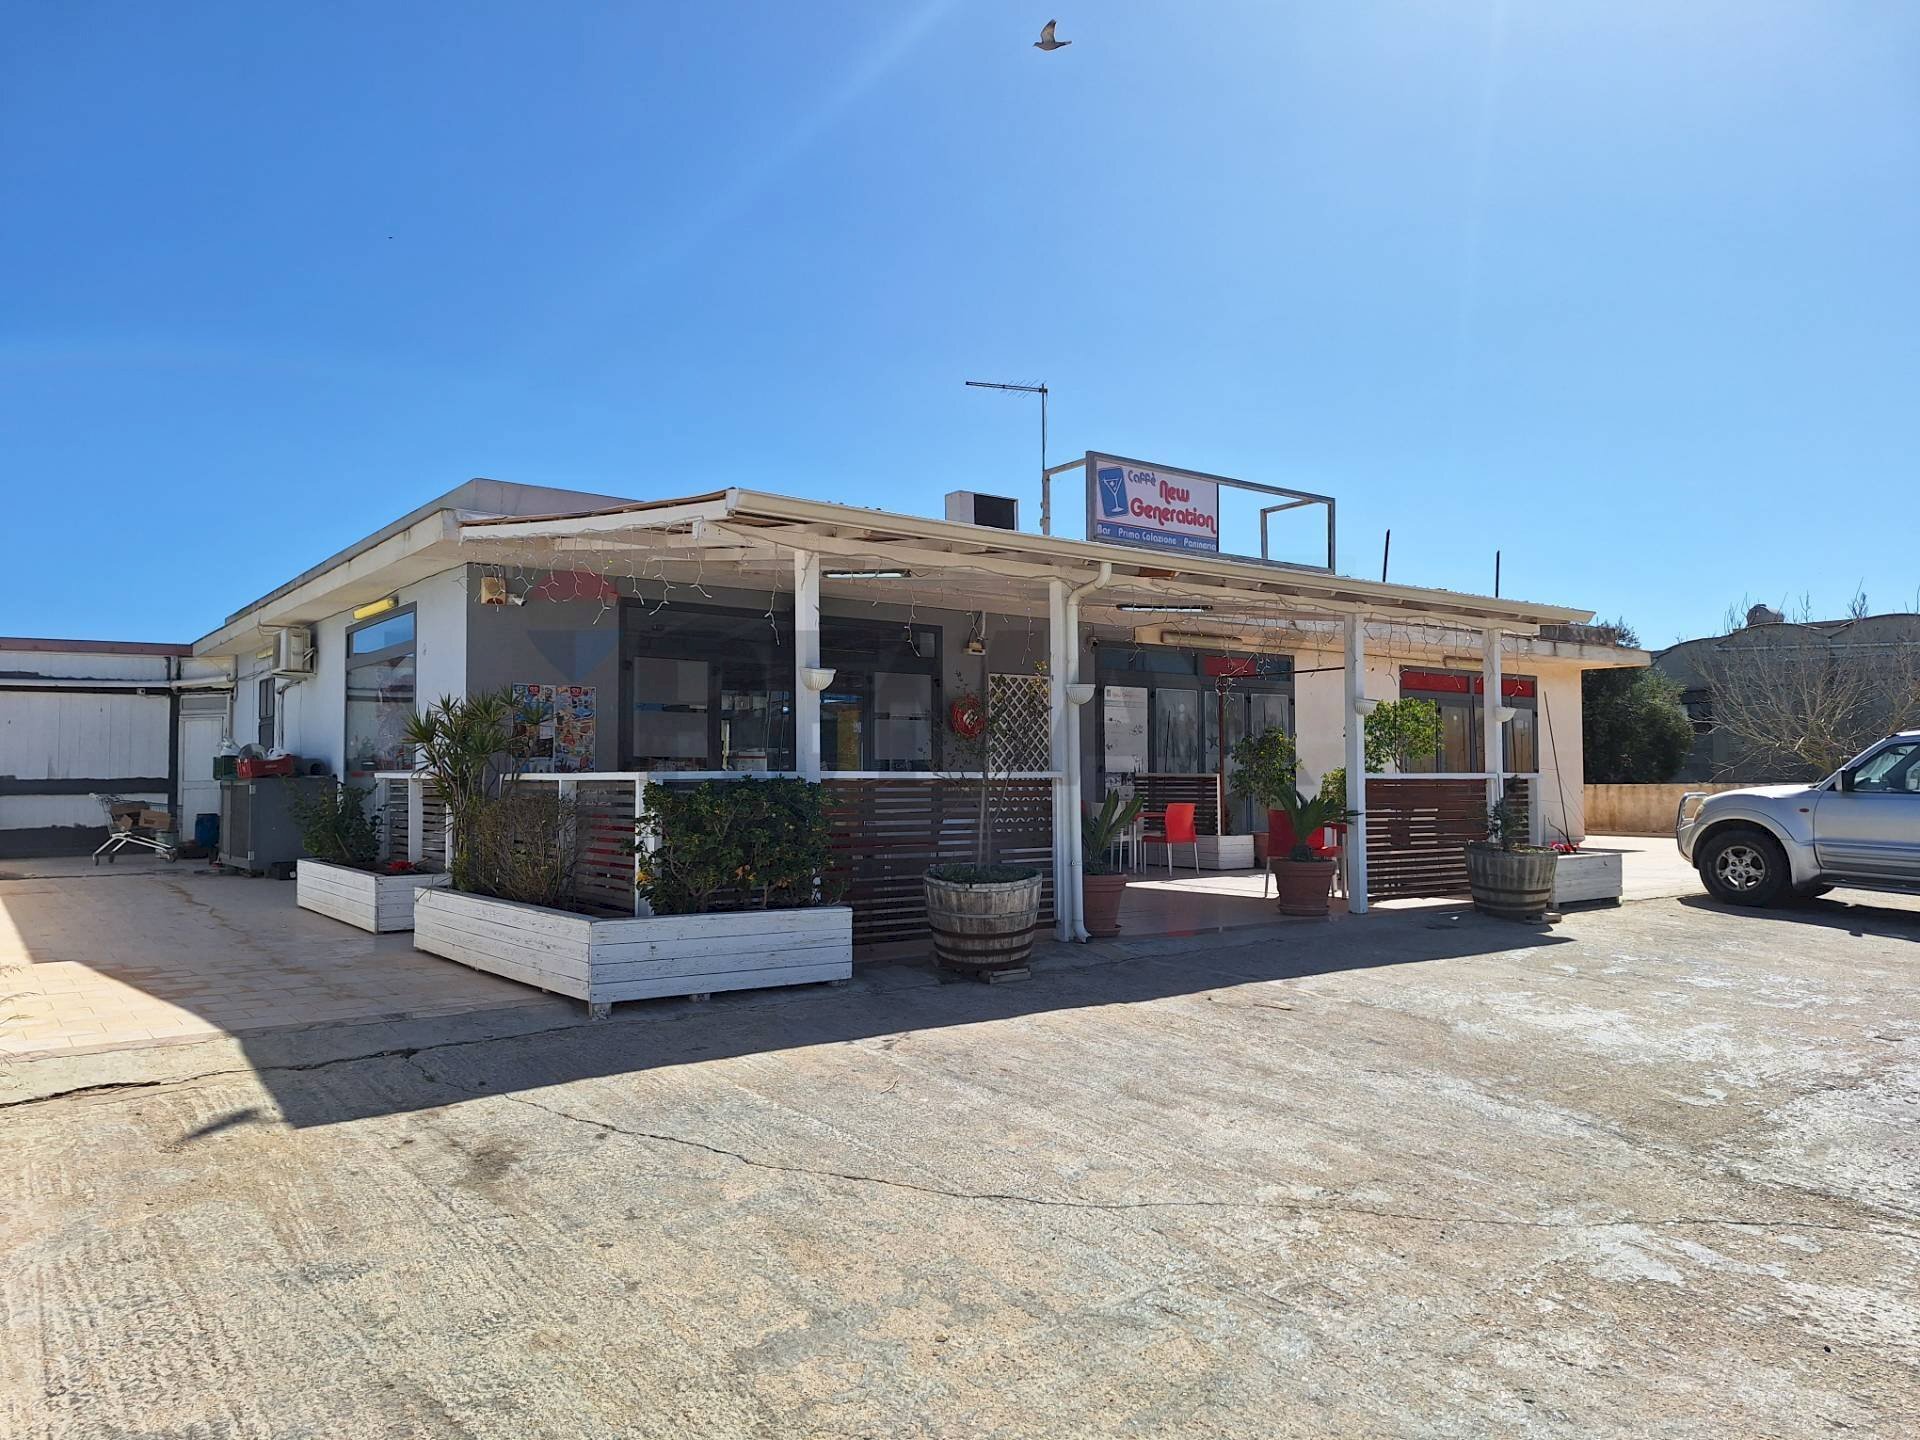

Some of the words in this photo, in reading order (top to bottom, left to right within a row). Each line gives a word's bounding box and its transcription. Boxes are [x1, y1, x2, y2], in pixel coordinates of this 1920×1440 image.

[1128, 470, 1156, 486] Caffè
[1160, 480, 1190, 504] New
[1130, 498, 1217, 534] Generation
[1097, 525, 1111, 535] Bar
[1118, 528, 1140, 539] Prima
[1142, 531, 1177, 544] Colazione
